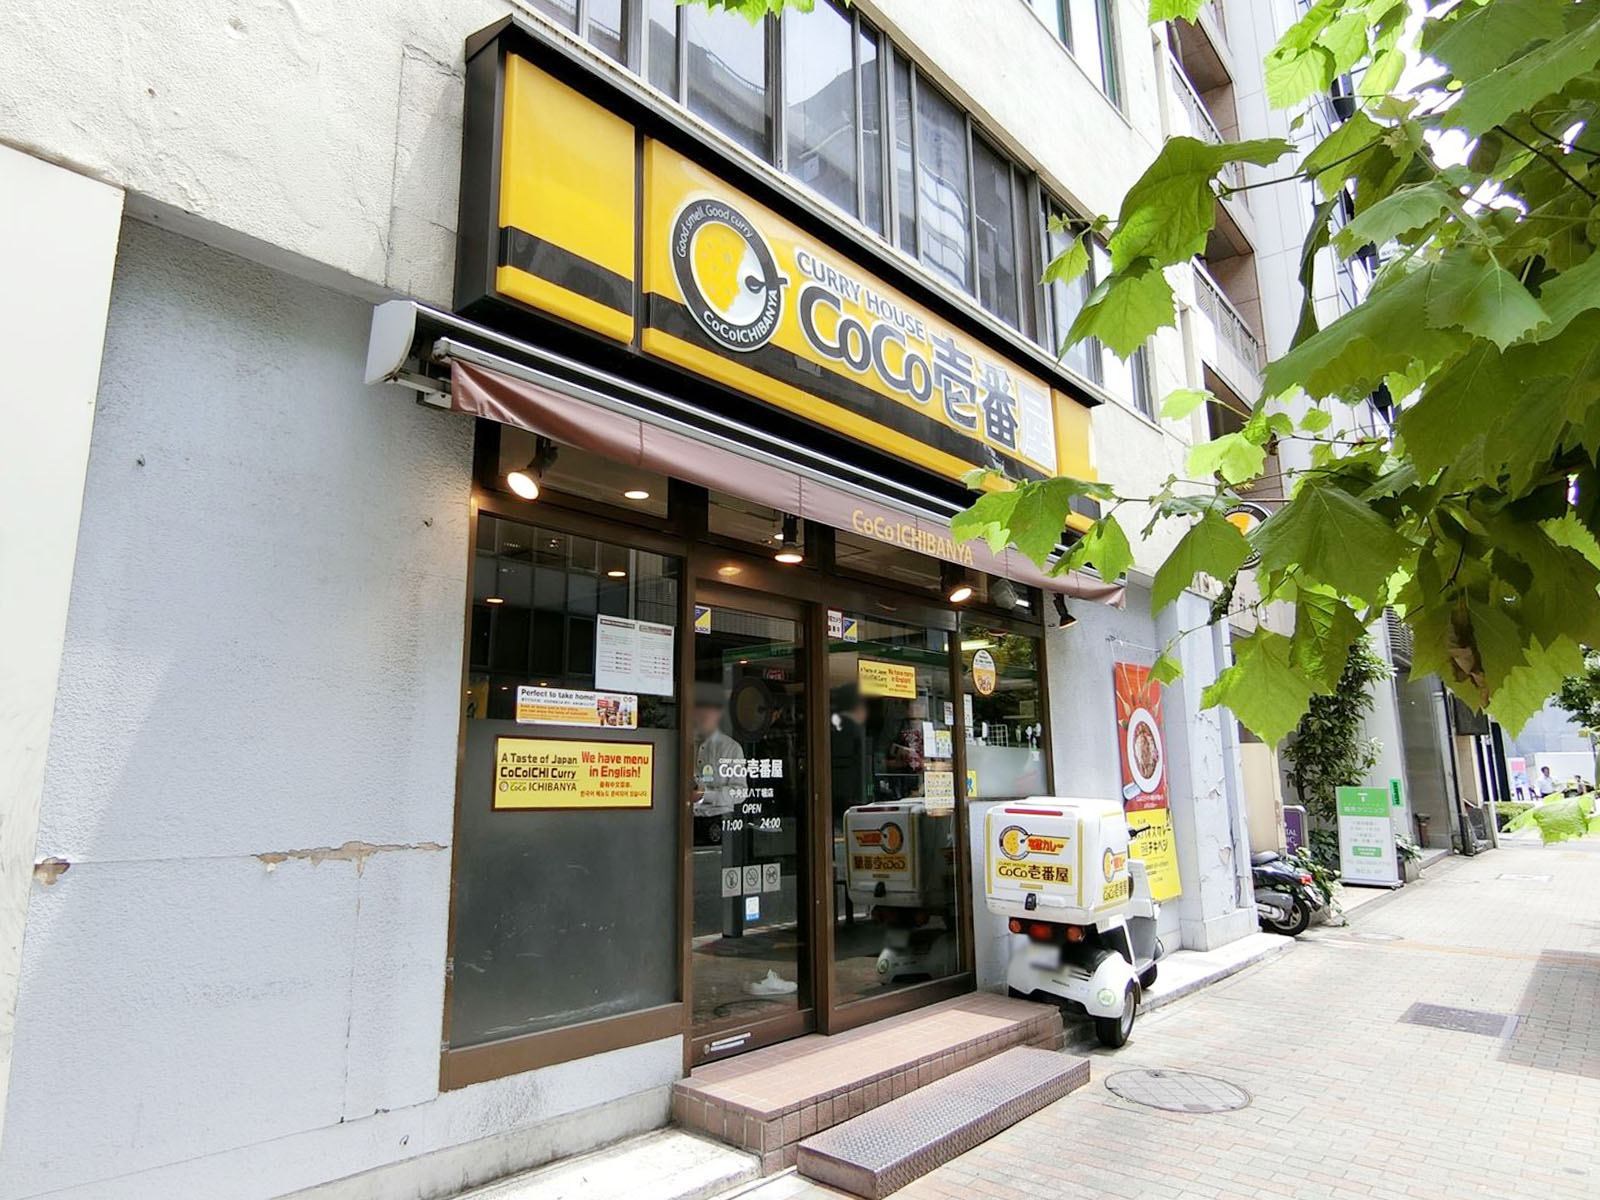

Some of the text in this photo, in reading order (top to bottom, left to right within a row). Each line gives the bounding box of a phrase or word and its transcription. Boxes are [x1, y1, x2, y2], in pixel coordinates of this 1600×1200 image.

[676, 224, 689, 258] Good
[705, 204, 730, 220] Good
[730, 215, 754, 238] curry
[798, 251, 925, 341] CURRY HOUSE
[521, 688, 596, 700] Perfect to take home!
[501, 752, 577, 765] A Taste of Japan
[581, 751, 649, 765] We have menu
[500, 766, 576, 779] CoCoICHI Curry
[589, 766, 641, 779] in English!
[510, 782, 577, 792] CoCo ICHIBANYA
[742, 803, 762, 814] OPEN
[722, 819, 743, 831] 11:00
[760, 817, 781, 829] 24:00
